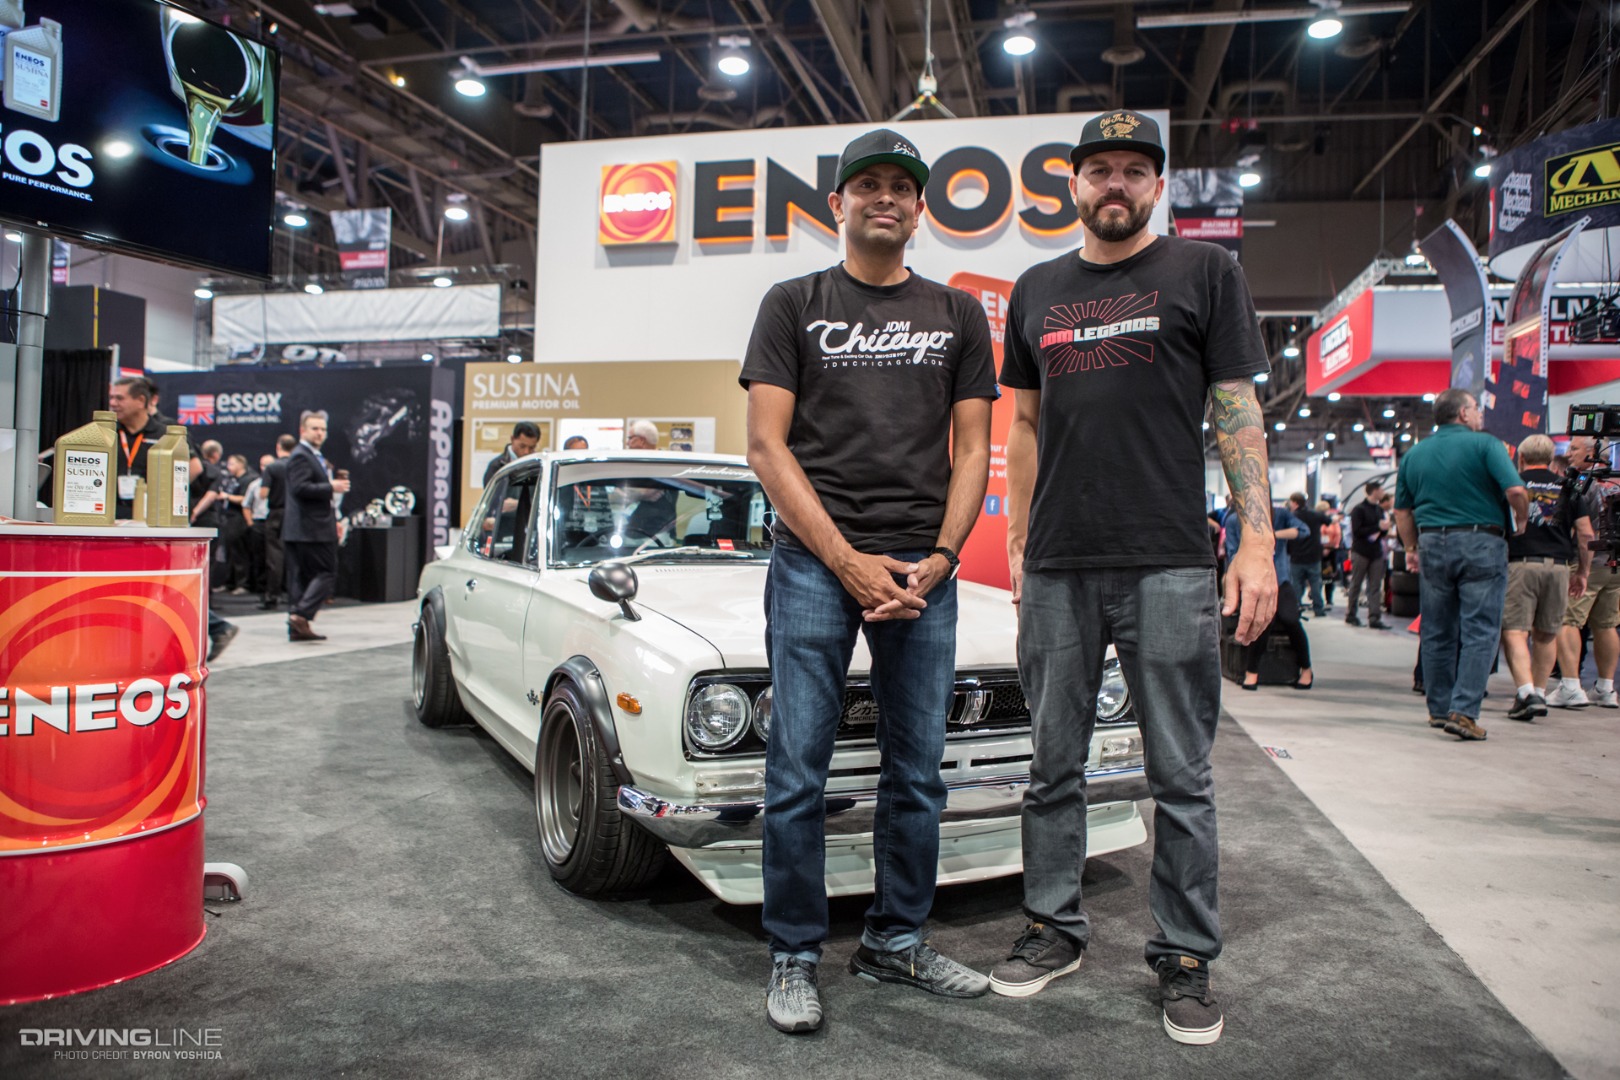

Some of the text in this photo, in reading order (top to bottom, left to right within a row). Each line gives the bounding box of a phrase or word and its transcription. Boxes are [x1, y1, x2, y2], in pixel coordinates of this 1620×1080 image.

[0, 123, 94, 188] OS
[2, 171, 27, 184] PURE
[693, 142, 1081, 243] ENOS
[882, 321, 911, 333] JDM
[473, 372, 580, 398] SUSTINA
[216, 392, 282, 413] essex
[472, 400, 580, 410] PREMIUM MOTOR OIL
[67, 456, 101, 465] ENEOS
[67, 467, 105, 477] SUSTINA
[0, 672, 192, 736] NEOS
